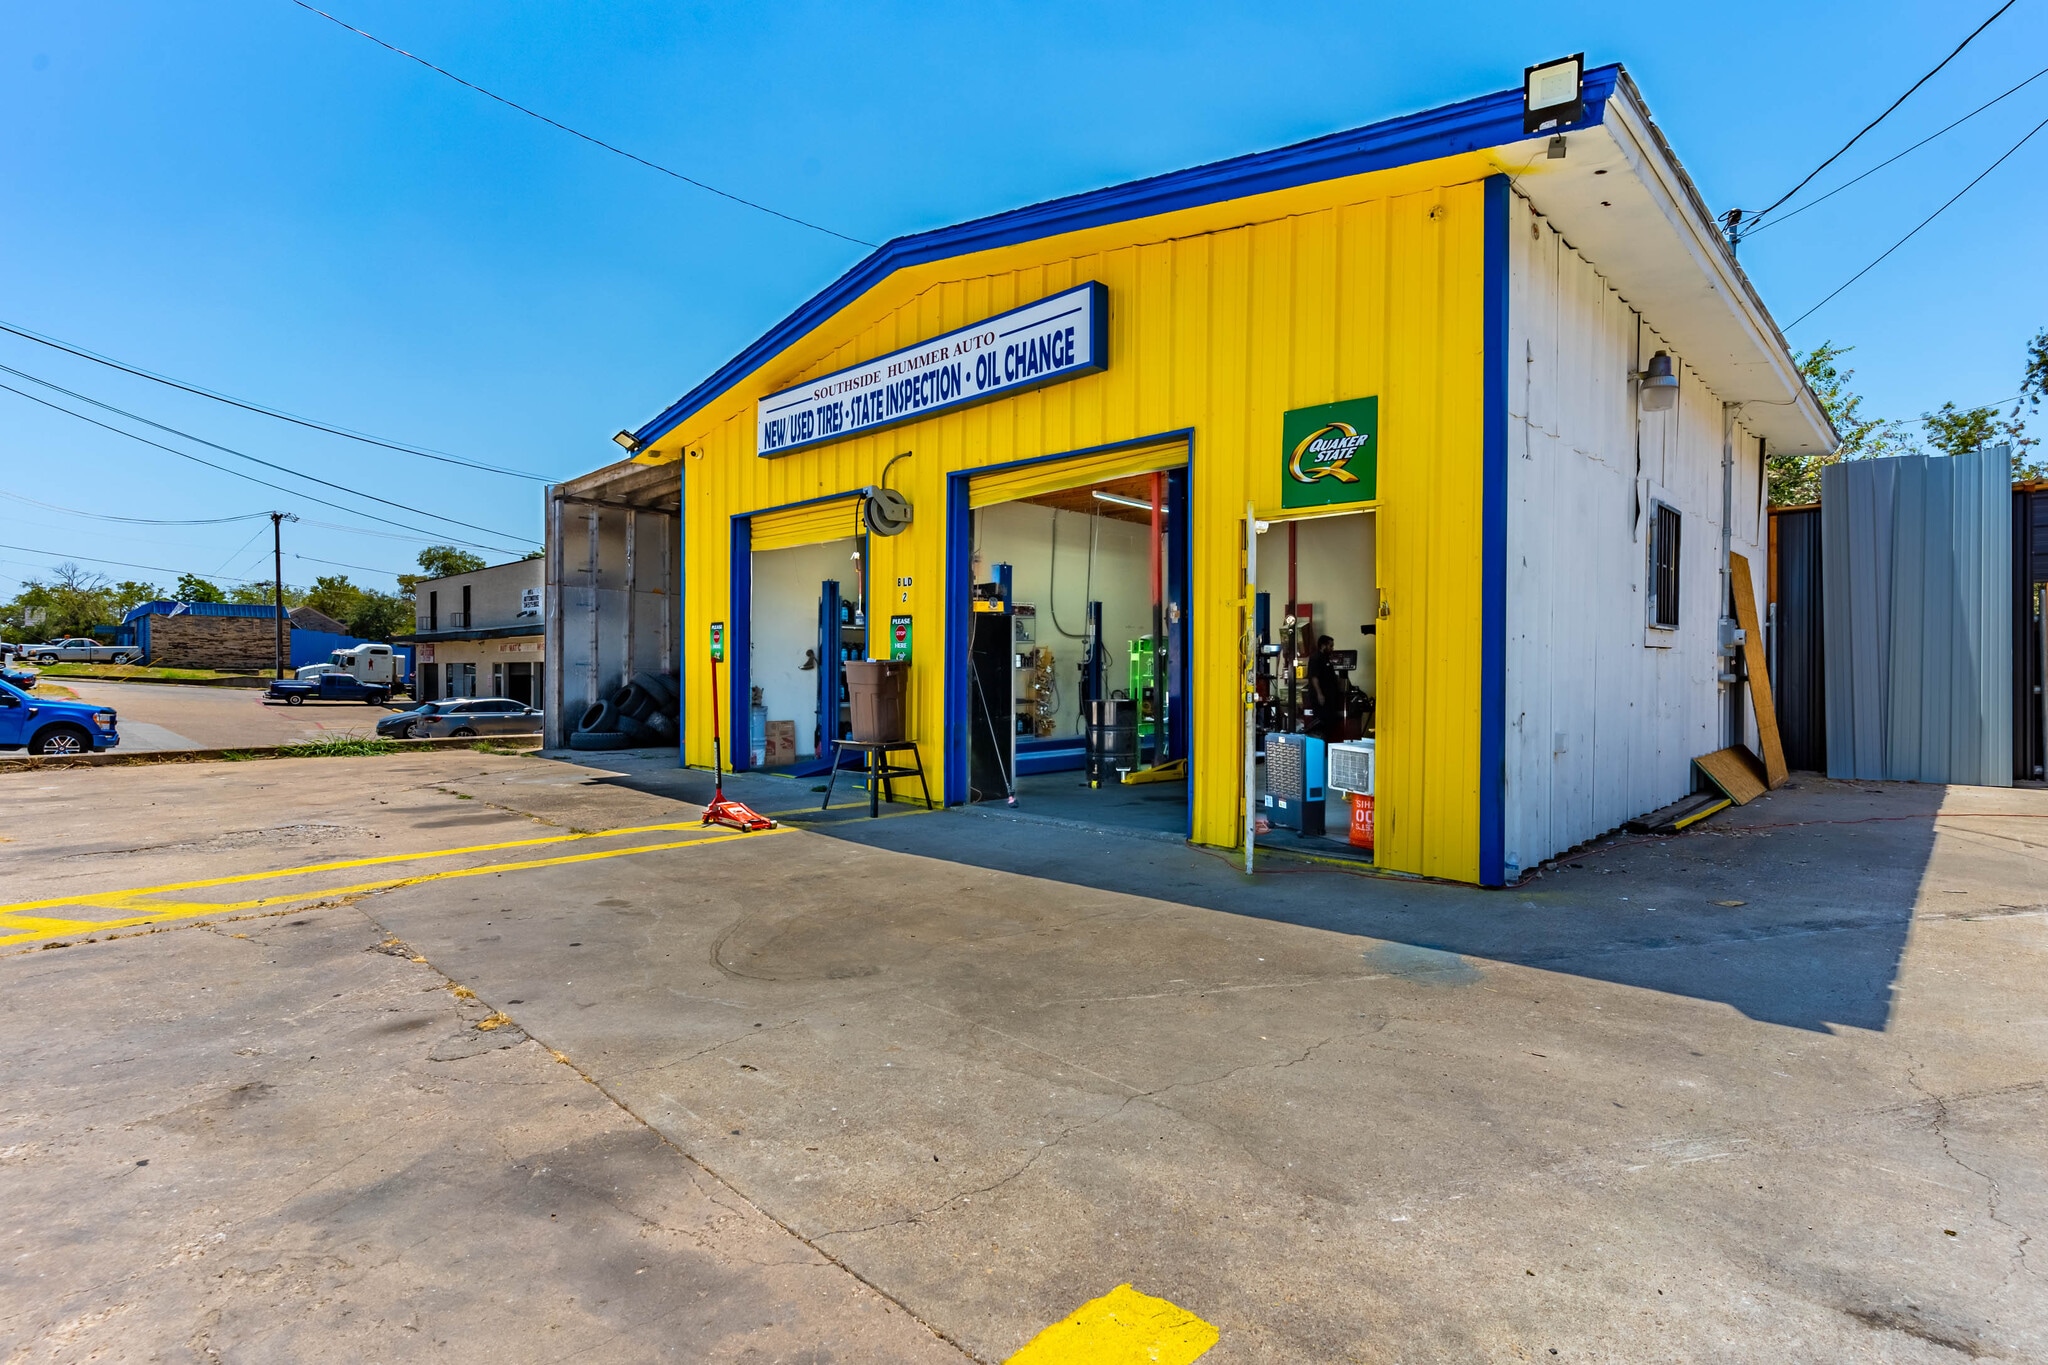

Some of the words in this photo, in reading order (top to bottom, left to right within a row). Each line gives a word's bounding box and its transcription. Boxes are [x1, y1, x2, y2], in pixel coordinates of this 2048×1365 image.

[813, 370, 881, 401] SOUTHSIDE
[887, 346, 950, 377] HUMMER
[953, 331, 995, 357] AUTO
[817, 400, 844, 436] TIRES
[850, 389, 883, 425] STATE
[885, 362, 961, 417] INSPECTION
[975, 353, 1001, 390] OIL
[1004, 326, 1075, 380] CHANGE
[1309, 434, 1368, 453] QUAKER
[1314, 447, 1357, 462] STATE
[902, 592, 908, 602] 2
